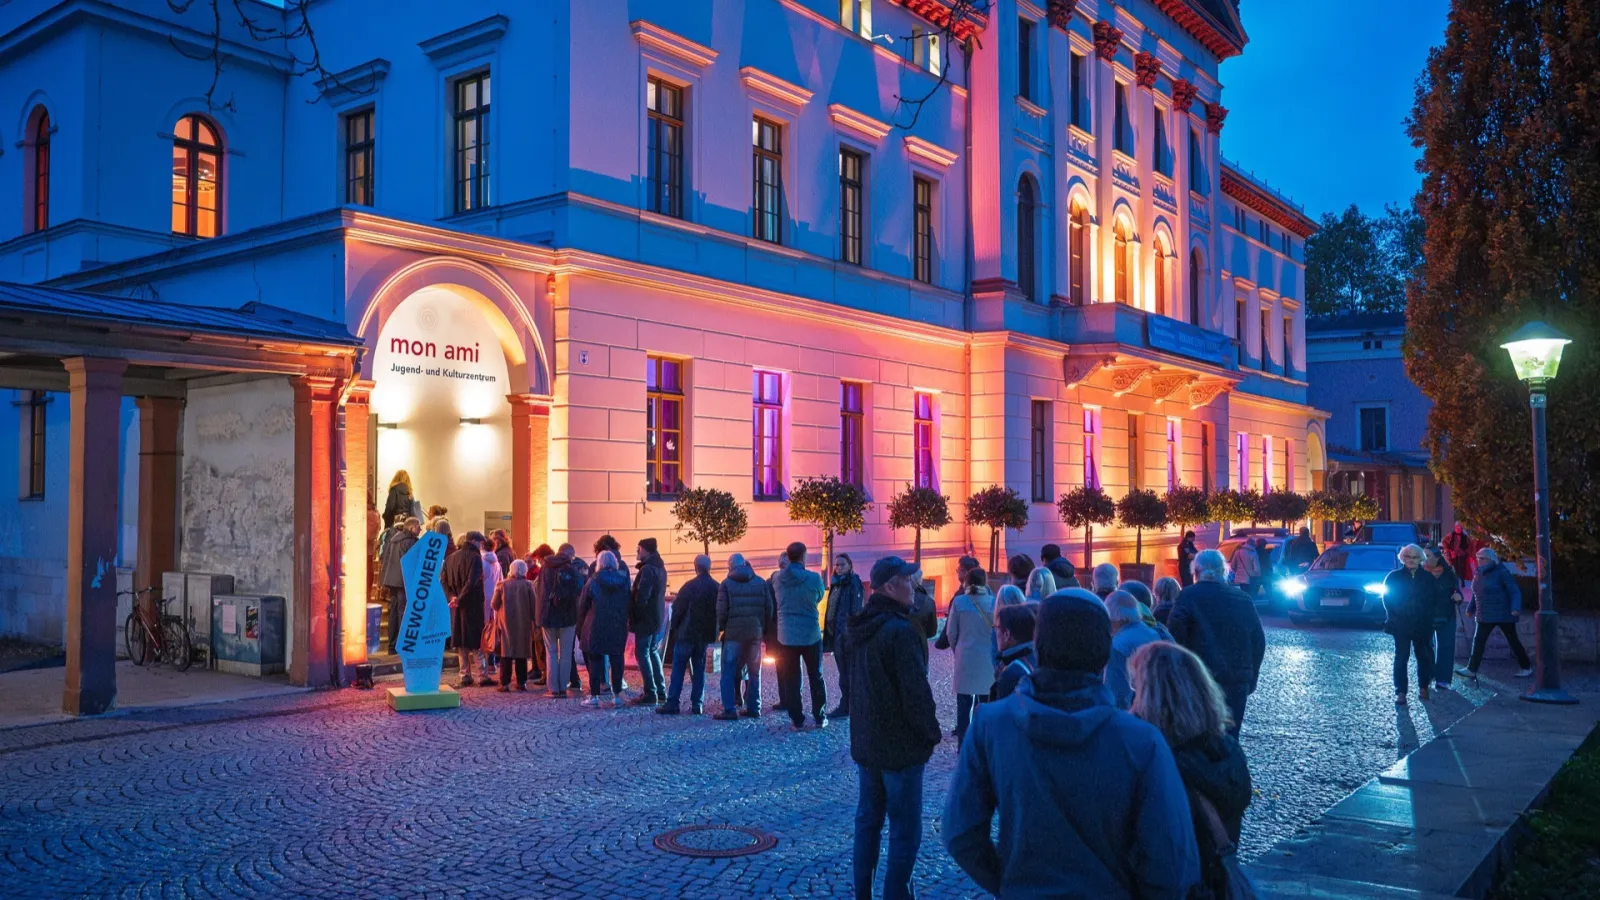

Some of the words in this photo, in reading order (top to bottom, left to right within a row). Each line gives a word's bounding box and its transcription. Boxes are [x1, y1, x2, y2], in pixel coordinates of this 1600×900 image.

[390, 337, 436, 358] mon
[444, 342, 480, 363] ami
[390, 363, 424, 375] Jugend-
[425, 367, 440, 377] und
[442, 368, 496, 382] Kulturzentrum
[402, 536, 442, 653] NEWCOMERS
